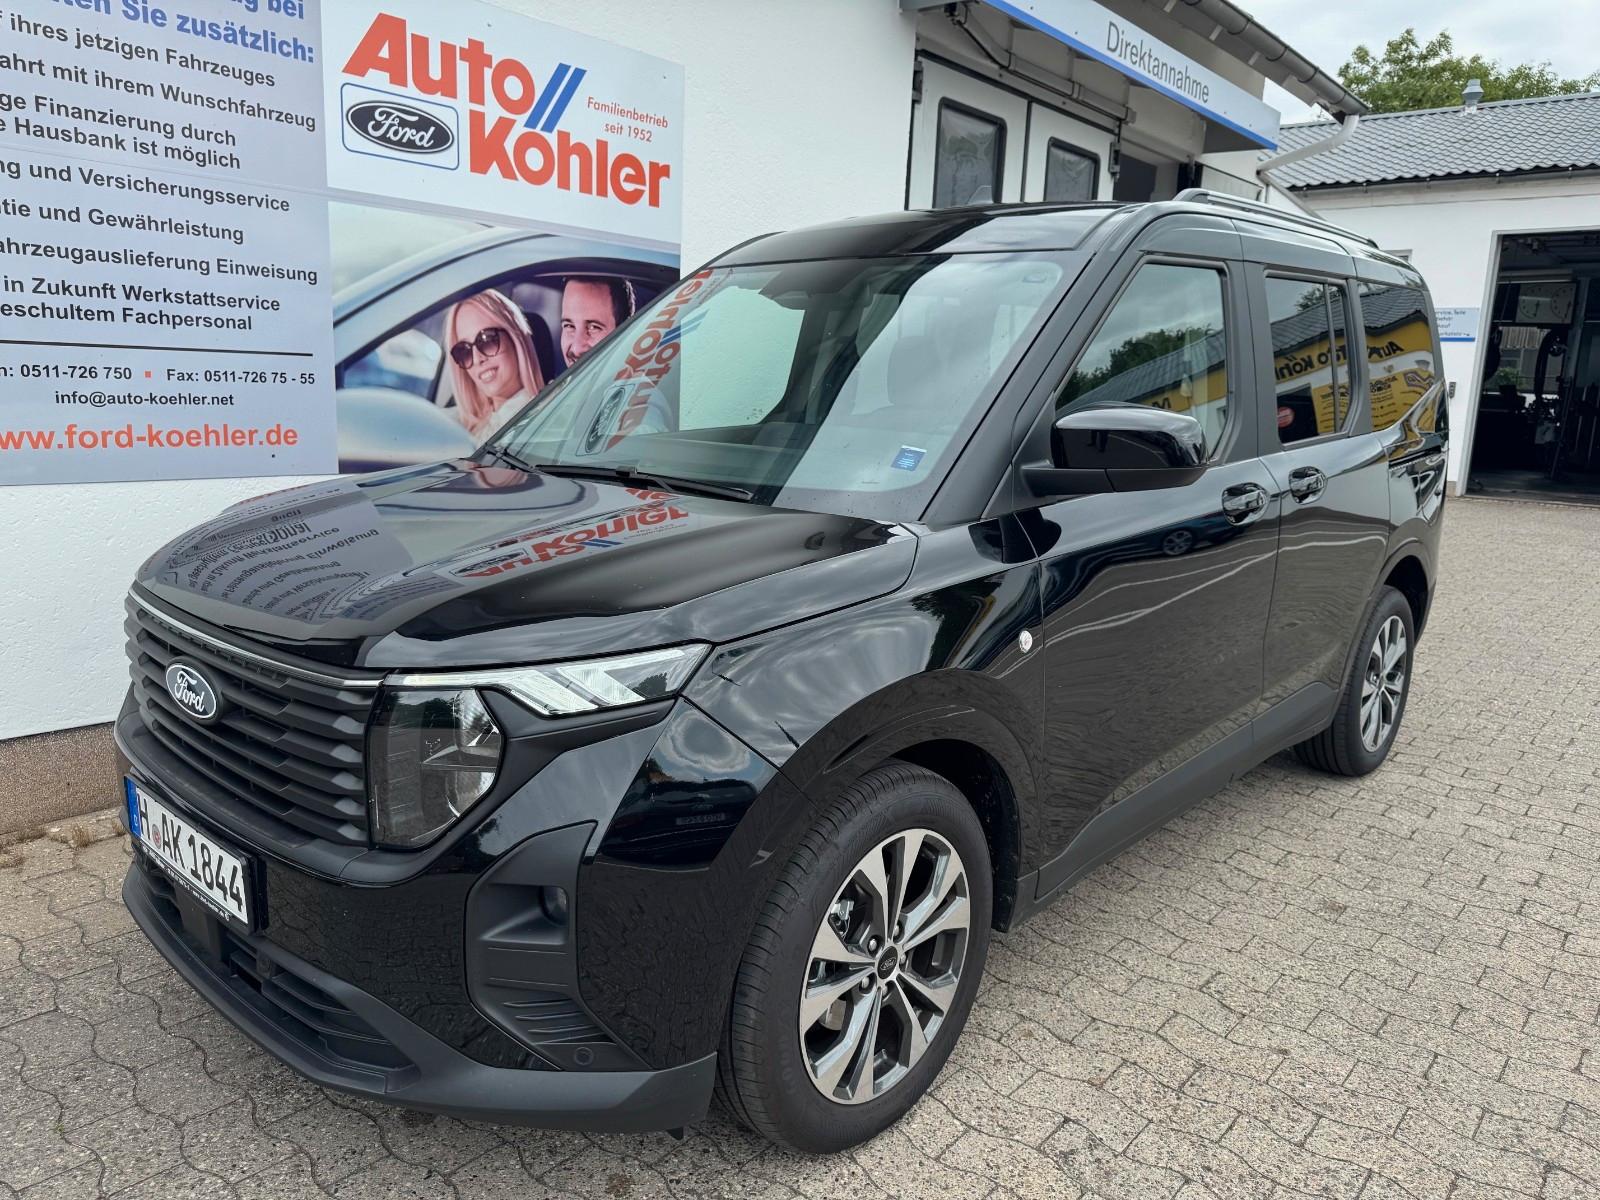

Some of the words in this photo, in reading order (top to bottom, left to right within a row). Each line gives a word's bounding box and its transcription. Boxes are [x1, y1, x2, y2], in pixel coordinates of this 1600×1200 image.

[10, 13, 69, 42] ihres
[75, 27, 159, 60] jetzigen
[166, 48, 275, 87] Fahrzeuges
[122, 0, 168, 28] Sie
[177, 14, 314, 63] zusätzlich:
[342, 12, 535, 116] Auto
[1107, 21, 1209, 104] Direktannahme
[53, 64, 88, 85] mit
[95, 70, 154, 97] ihrem
[160, 83, 316, 132] Wunschfahrzeug
[587, 96, 669, 129] Familienbetrieb
[35, 96, 175, 140] Finanzierung
[181, 123, 236, 147] durch
[367, 106, 436, 149] Ford
[604, 122, 624, 136] seit
[627, 124, 653, 143] 1952
[15, 116, 126, 151] Hausbank
[133, 139, 158, 157] ist
[164, 147, 241, 170] möglich
[29, 162, 72, 183] und
[79, 167, 290, 212] Versicherungsservice
[39, 204, 80, 223] und
[88, 208, 244, 245] Gewährleistung
[216, 258, 318, 285] Einweisung
[4, 276, 24, 293] in
[32, 277, 116, 299] Zukunft
[122, 284, 280, 311] Werkstattservice
[122, 307, 252, 330] Fachpersonal
[20, 364, 98, 379] 0511-726
[103, 366, 132, 380] 750
[167, 368, 199, 382] Fax:
[204, 370, 267, 383] 0511-726
[272, 370, 287, 384] 75
[300, 373, 315, 385] 55
[55, 391, 234, 407] info@auto-koehler.net
[174, 670, 205, 712] Ford
[137, 793, 150, 841] H
[161, 812, 186, 870] AK
[188, 834, 244, 912] 1844
